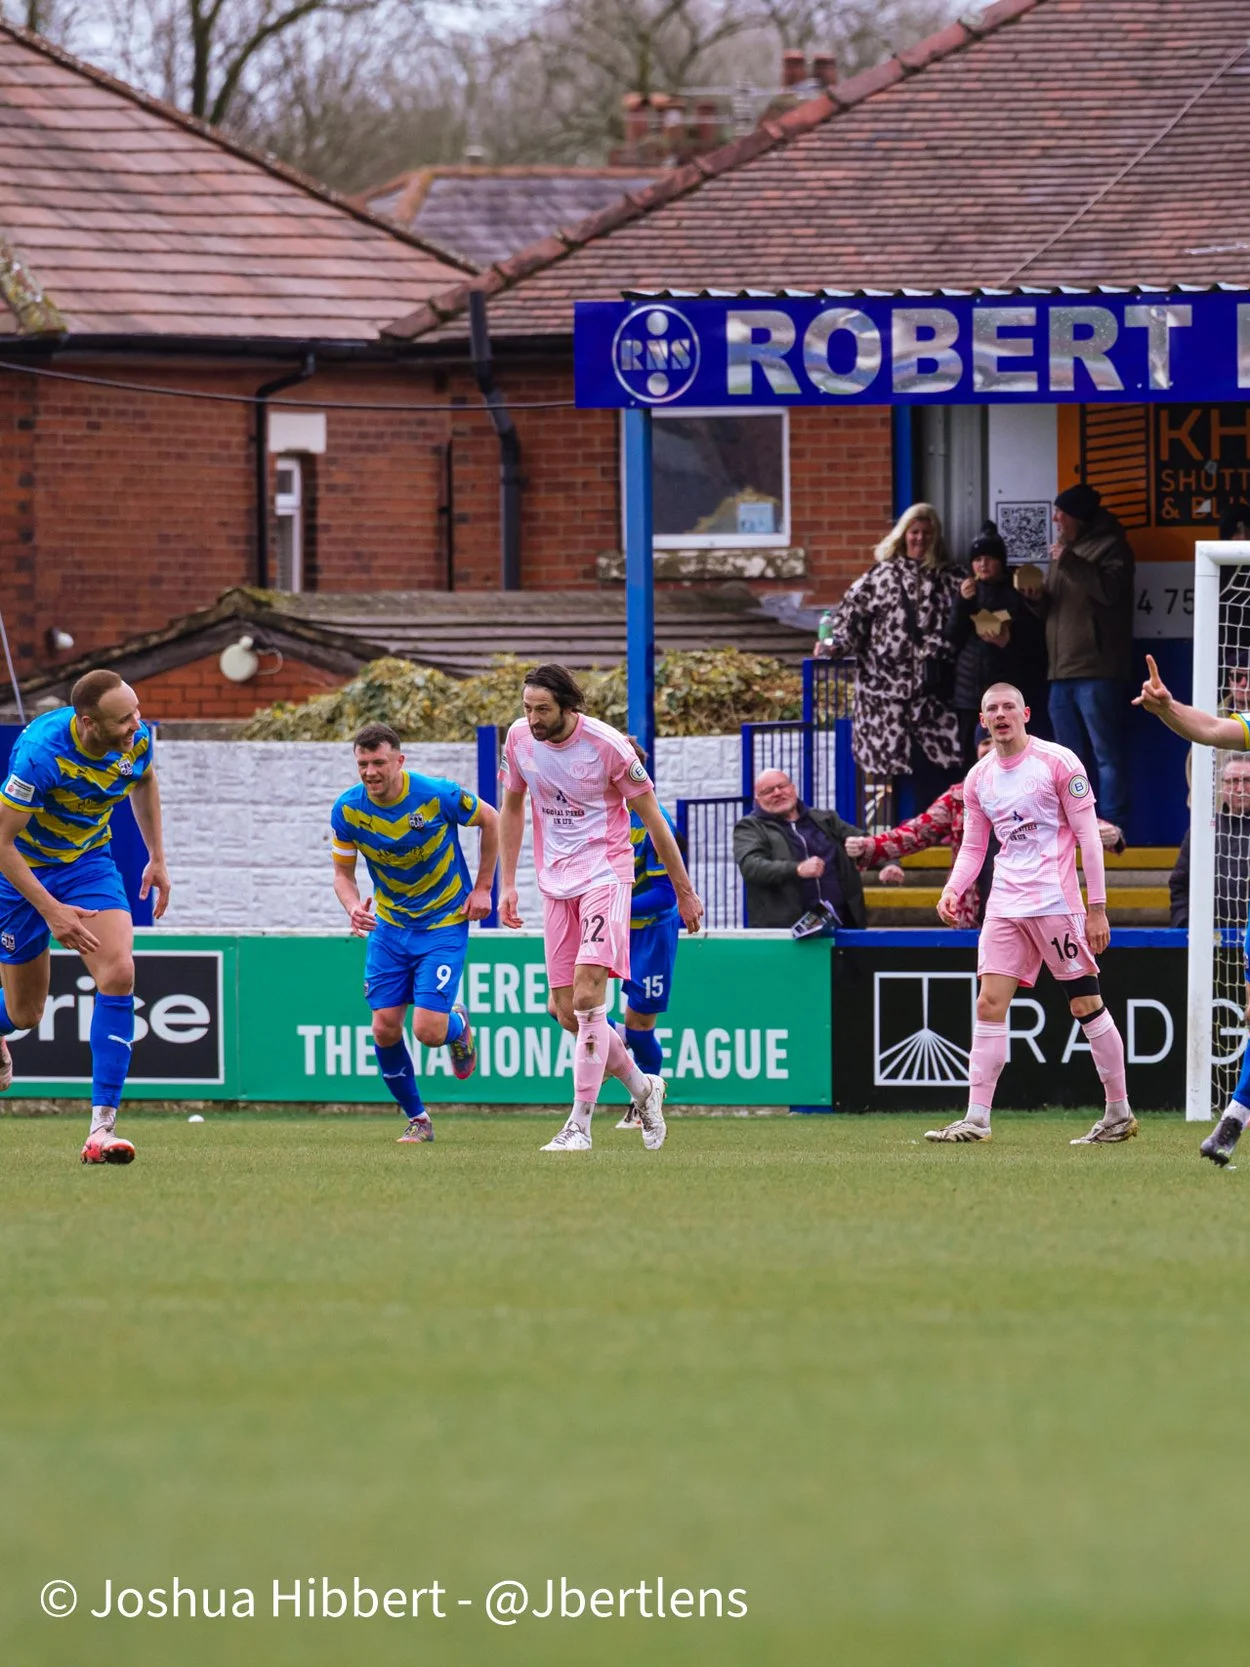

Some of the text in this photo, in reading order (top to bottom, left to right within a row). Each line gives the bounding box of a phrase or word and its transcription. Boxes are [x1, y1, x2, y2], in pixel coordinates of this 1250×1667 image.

[620, 338, 691, 371] RNS
[726, 304, 1192, 395] ROBERT
[1161, 498, 1180, 519] &
[1050, 932, 1079, 963] 16
[436, 964, 452, 991] 9
[454, 963, 547, 1014] ERE
[642, 974, 665, 999] 15
[296, 1025, 379, 1076] THE
[652, 1028, 789, 1080] EAGUE
